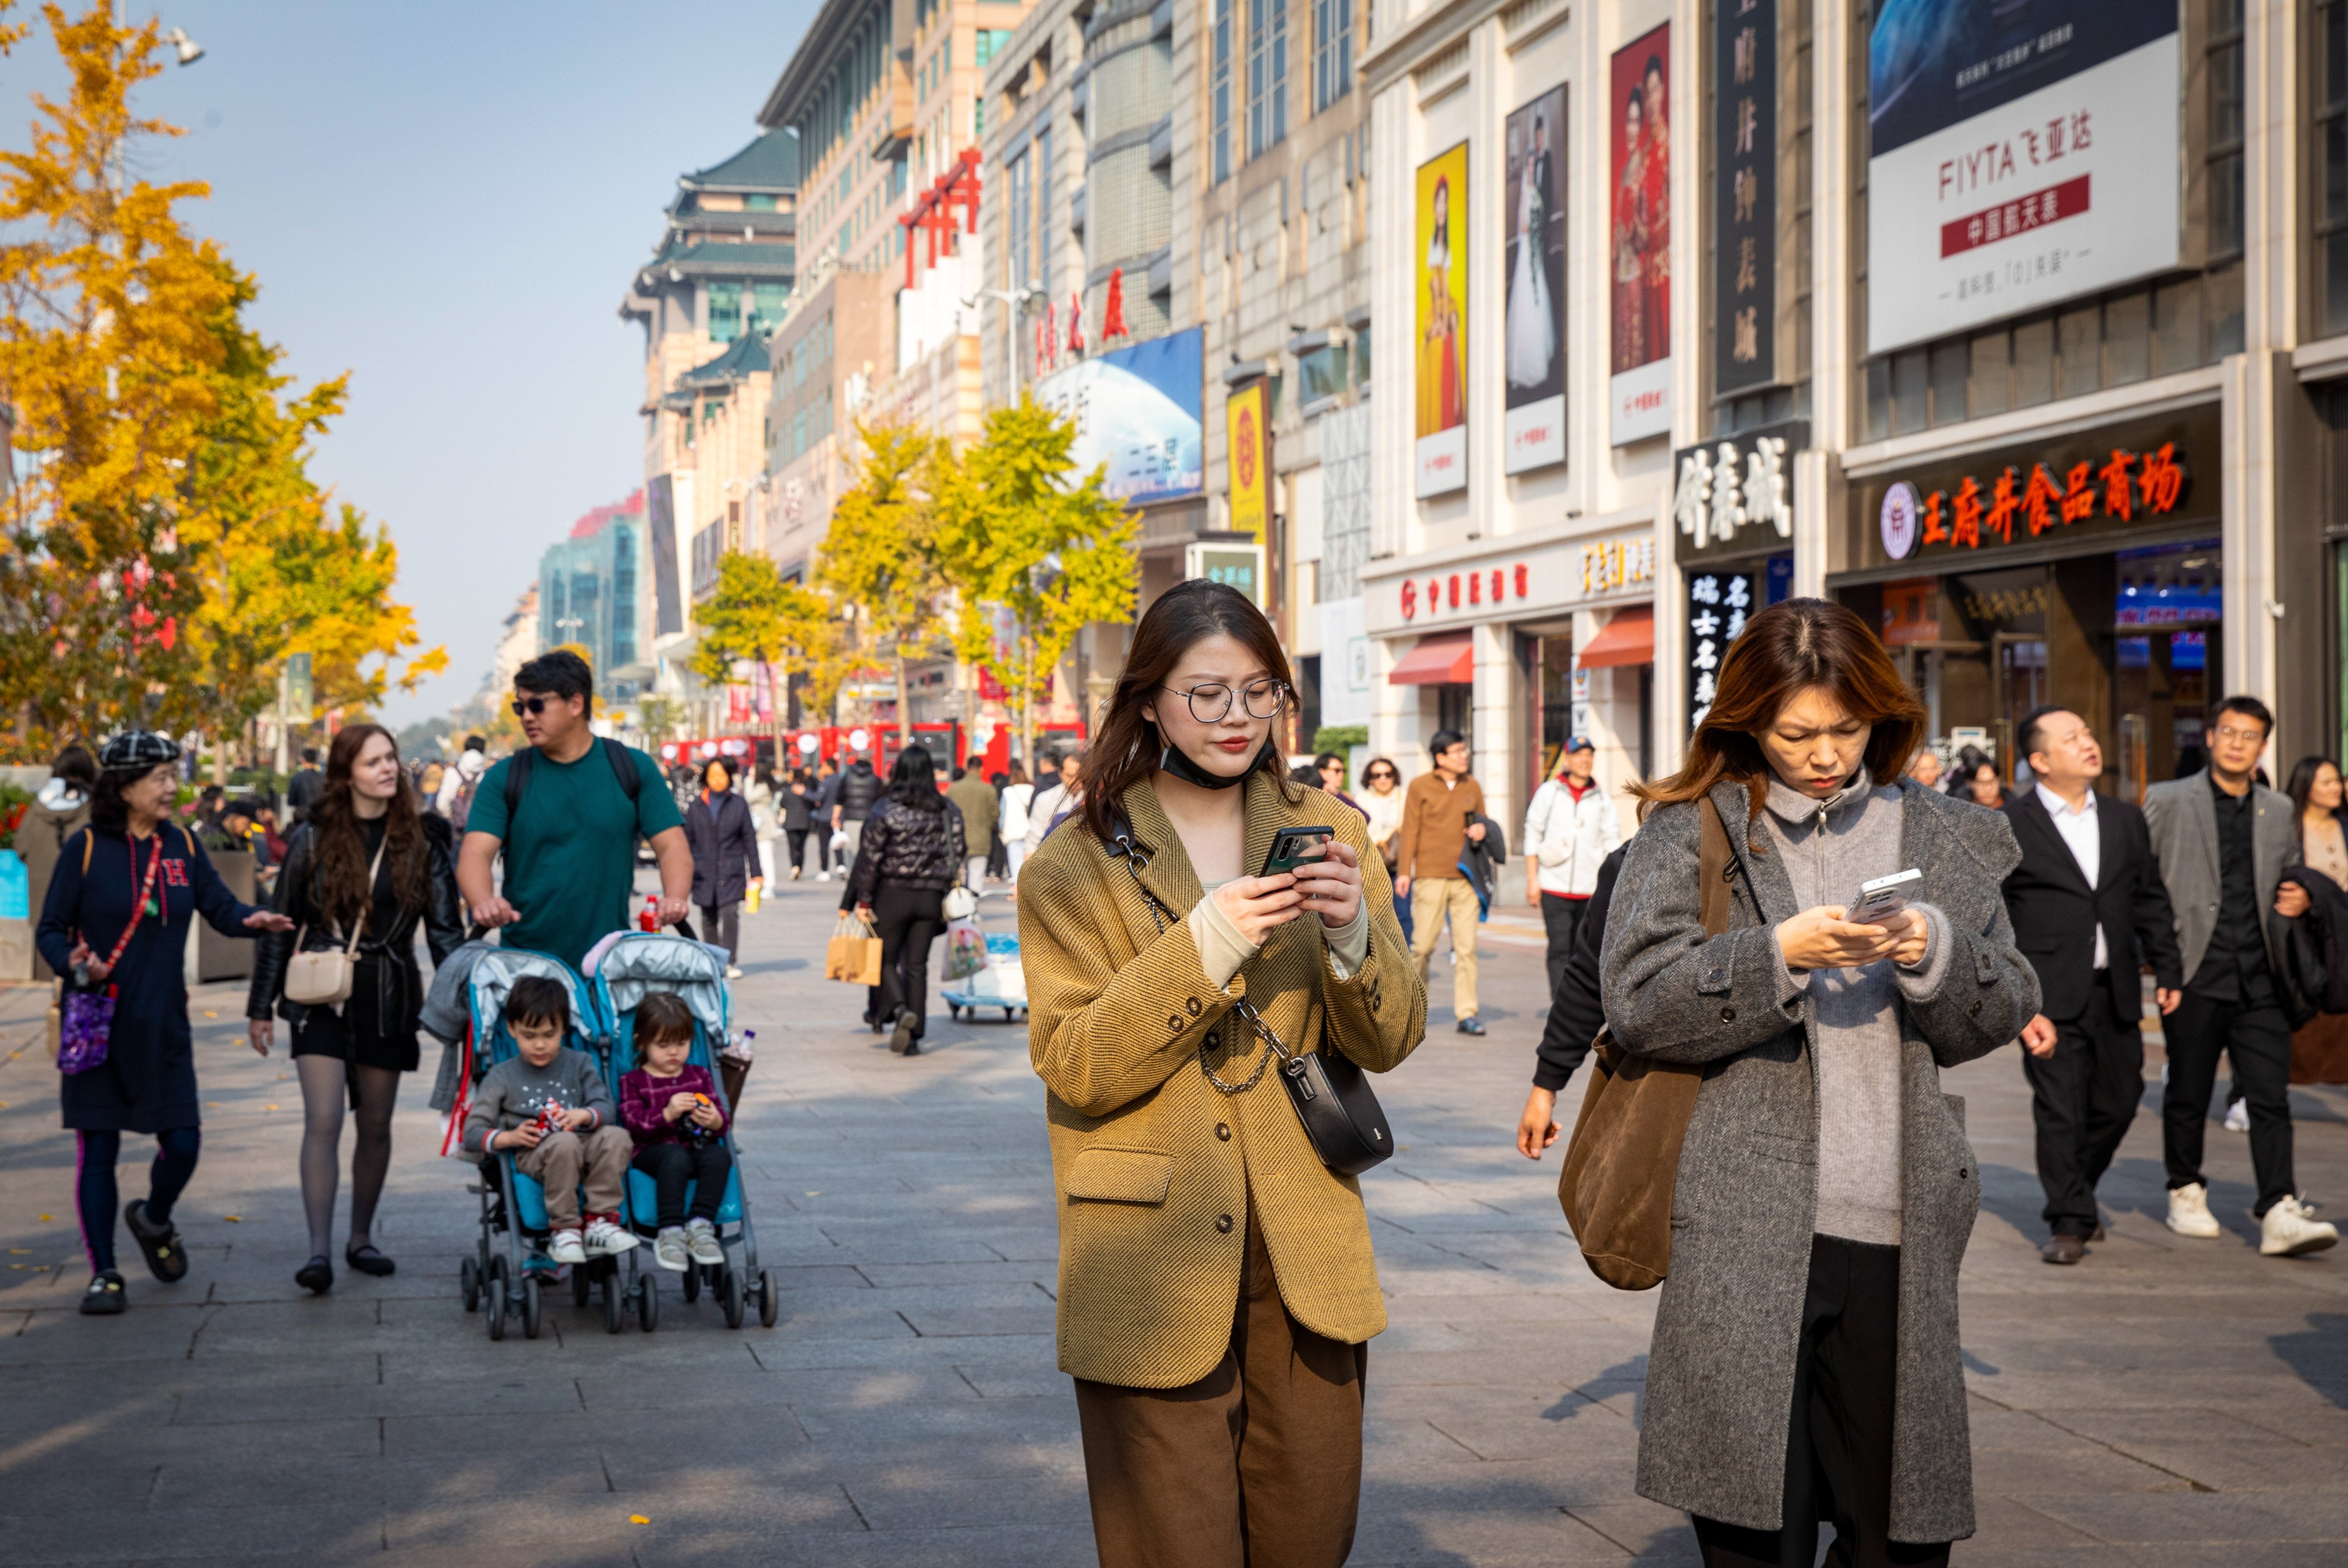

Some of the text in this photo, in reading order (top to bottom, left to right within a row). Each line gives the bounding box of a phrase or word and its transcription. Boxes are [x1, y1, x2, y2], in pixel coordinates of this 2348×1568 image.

[1939, 110, 2092, 201] FIYTA 飞亚达
[1967, 189, 2058, 247] 中国航天表
[1923, 443, 2182, 549] 王府井食品商场
[161, 858, 190, 887] H
